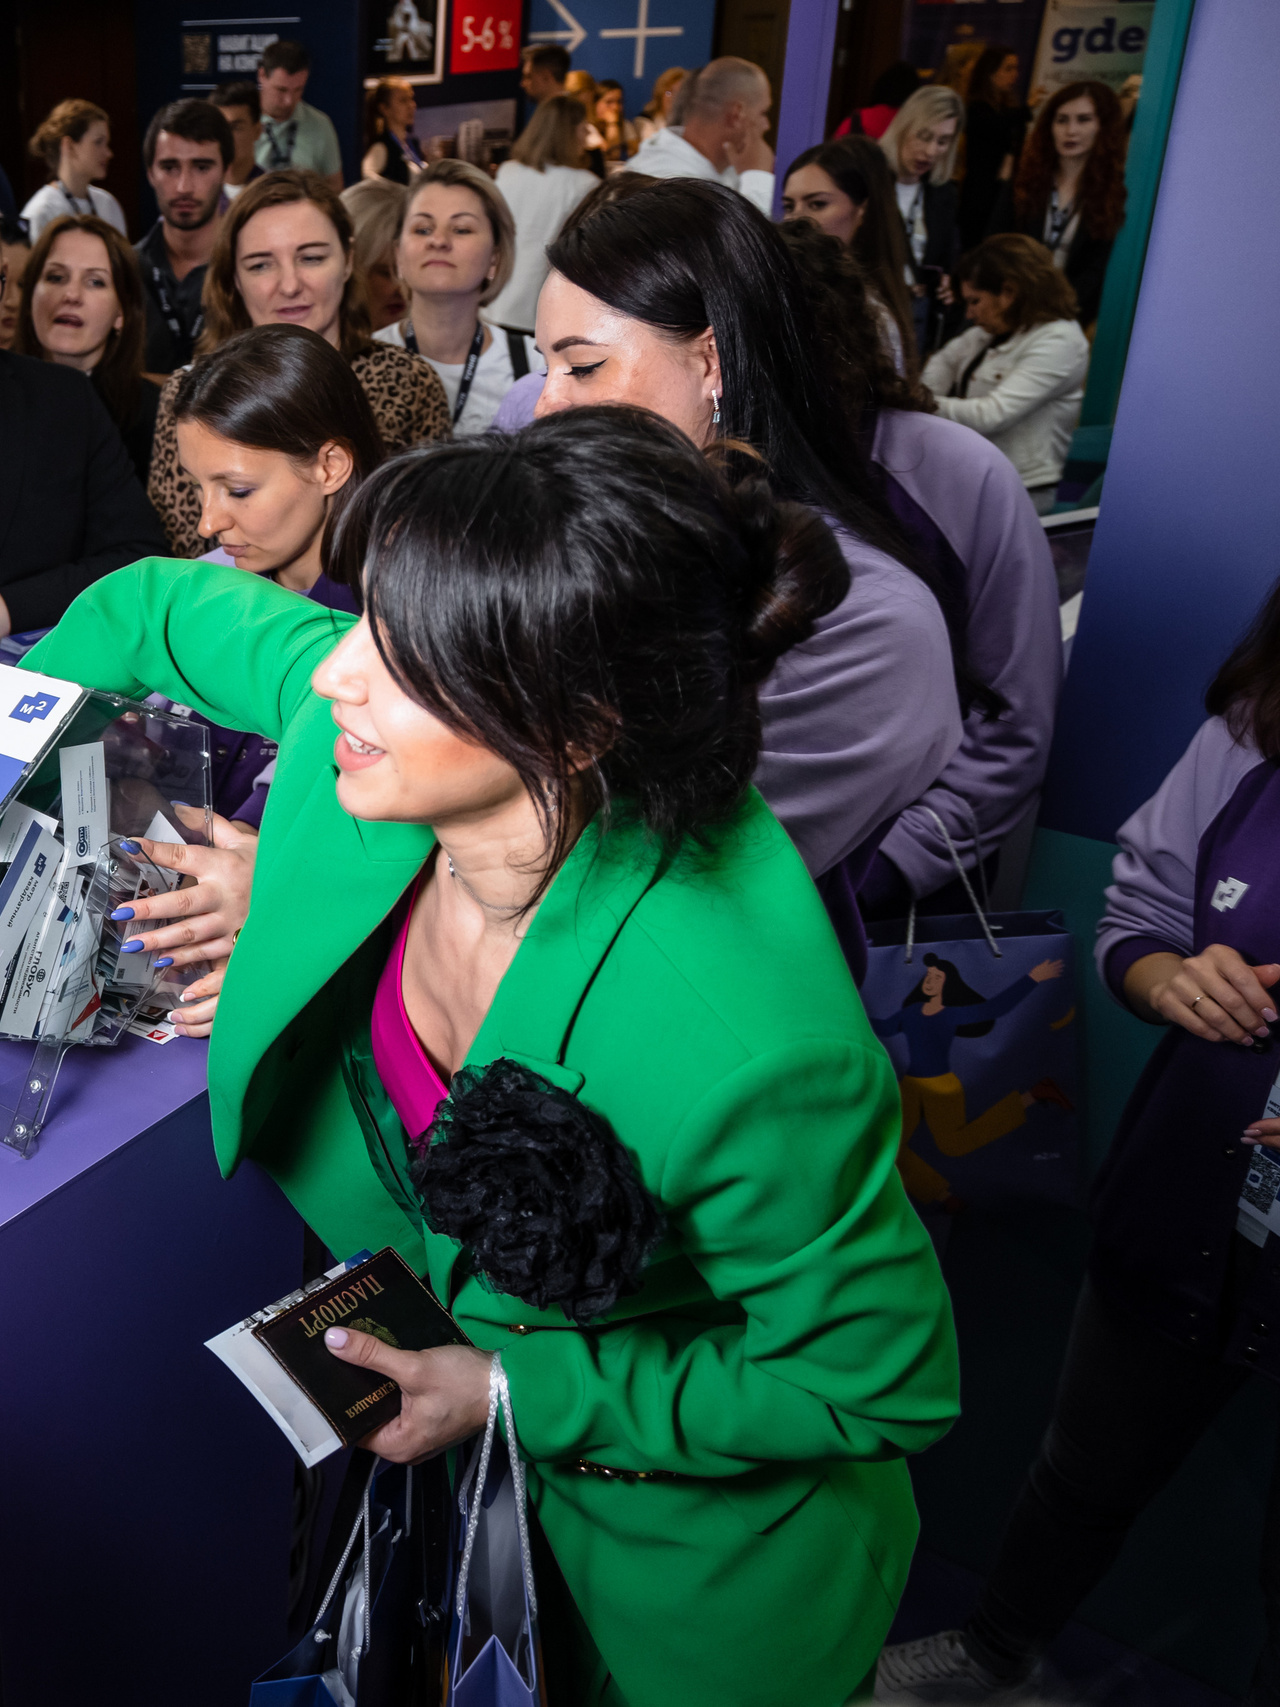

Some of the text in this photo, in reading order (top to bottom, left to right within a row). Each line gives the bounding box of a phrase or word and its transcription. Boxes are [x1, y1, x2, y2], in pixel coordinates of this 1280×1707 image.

[6, 876, 34, 928] квадратный
[26, 880, 38, 902] метр
[23, 951, 42, 998] ГЛОБУС
[297, 1273, 385, 1339] ПАСПОРТ
